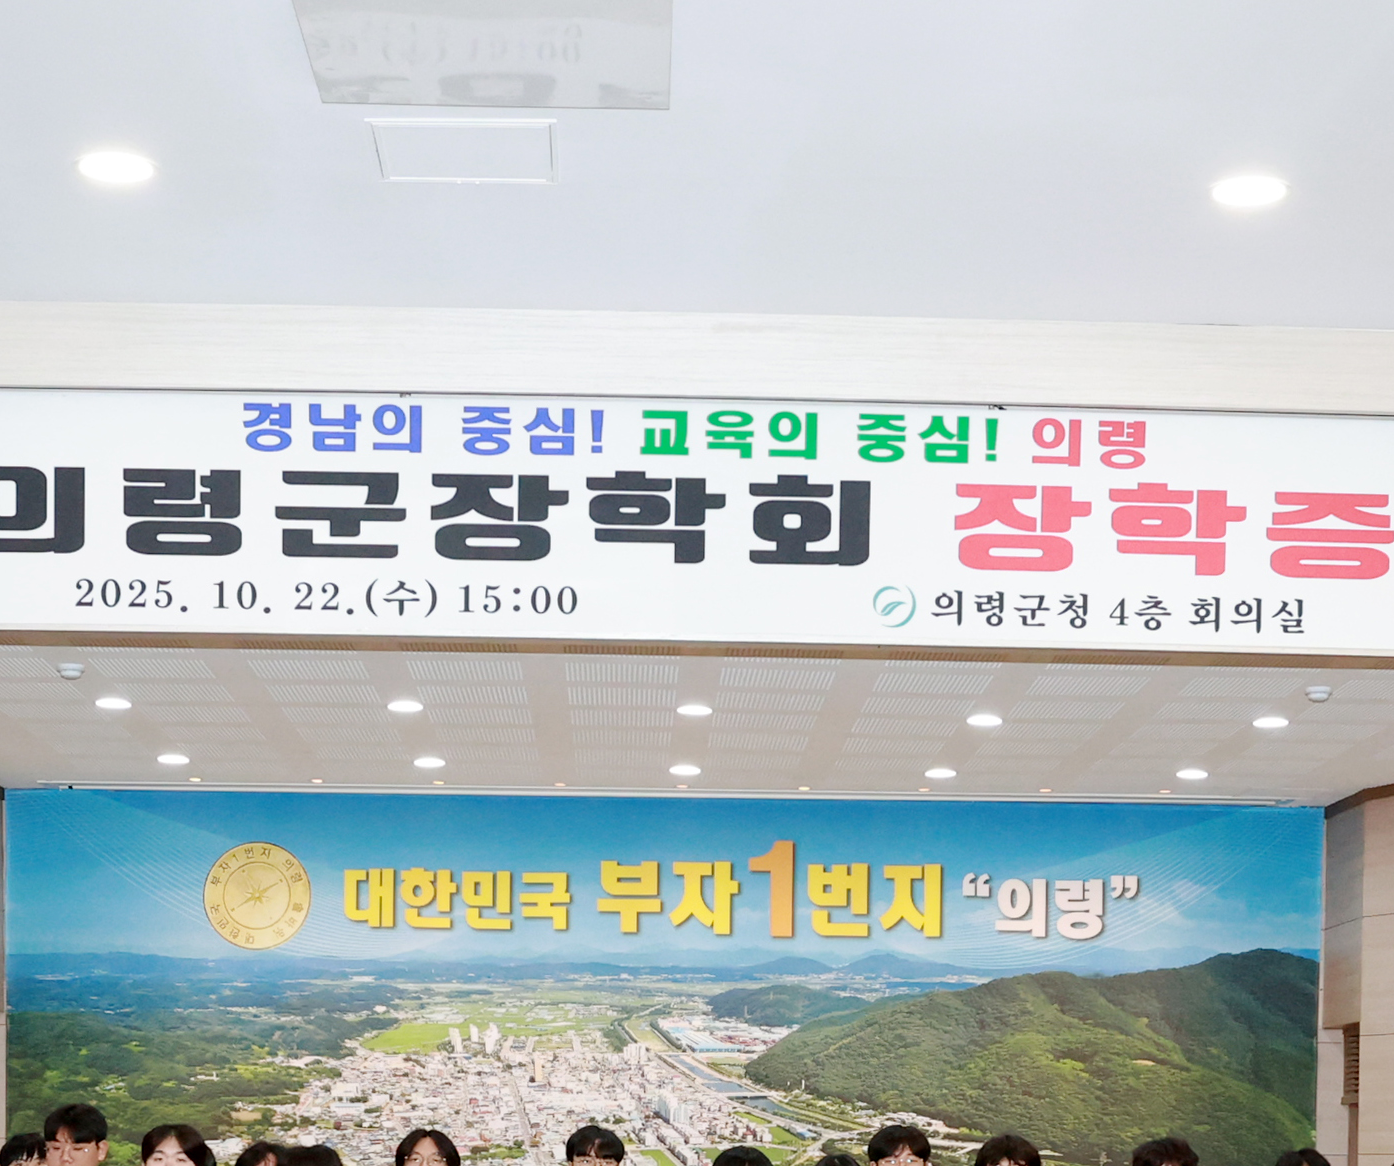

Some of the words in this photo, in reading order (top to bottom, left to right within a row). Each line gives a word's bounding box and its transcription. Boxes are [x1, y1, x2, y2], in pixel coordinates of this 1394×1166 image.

[243, 402, 423, 454] 경남의
[461, 406, 604, 456] 중심!
[640, 410, 818, 460] 교육의
[858, 412, 1001, 464] 중심!
[1032, 419, 1150, 469] 의령
[75, 578, 188, 612] 2025.
[214, 581, 271, 614] 10.
[294, 579, 437, 617] 22.(수)
[459, 585, 577, 614] 15:00
[931, 590, 1088, 629] 의령군청
[1109, 595, 1171, 631] 4층
[1189, 597, 1304, 633] 회의실
[343, 867, 571, 931] 대한민국
[597, 840, 943, 938] 부자1번지
